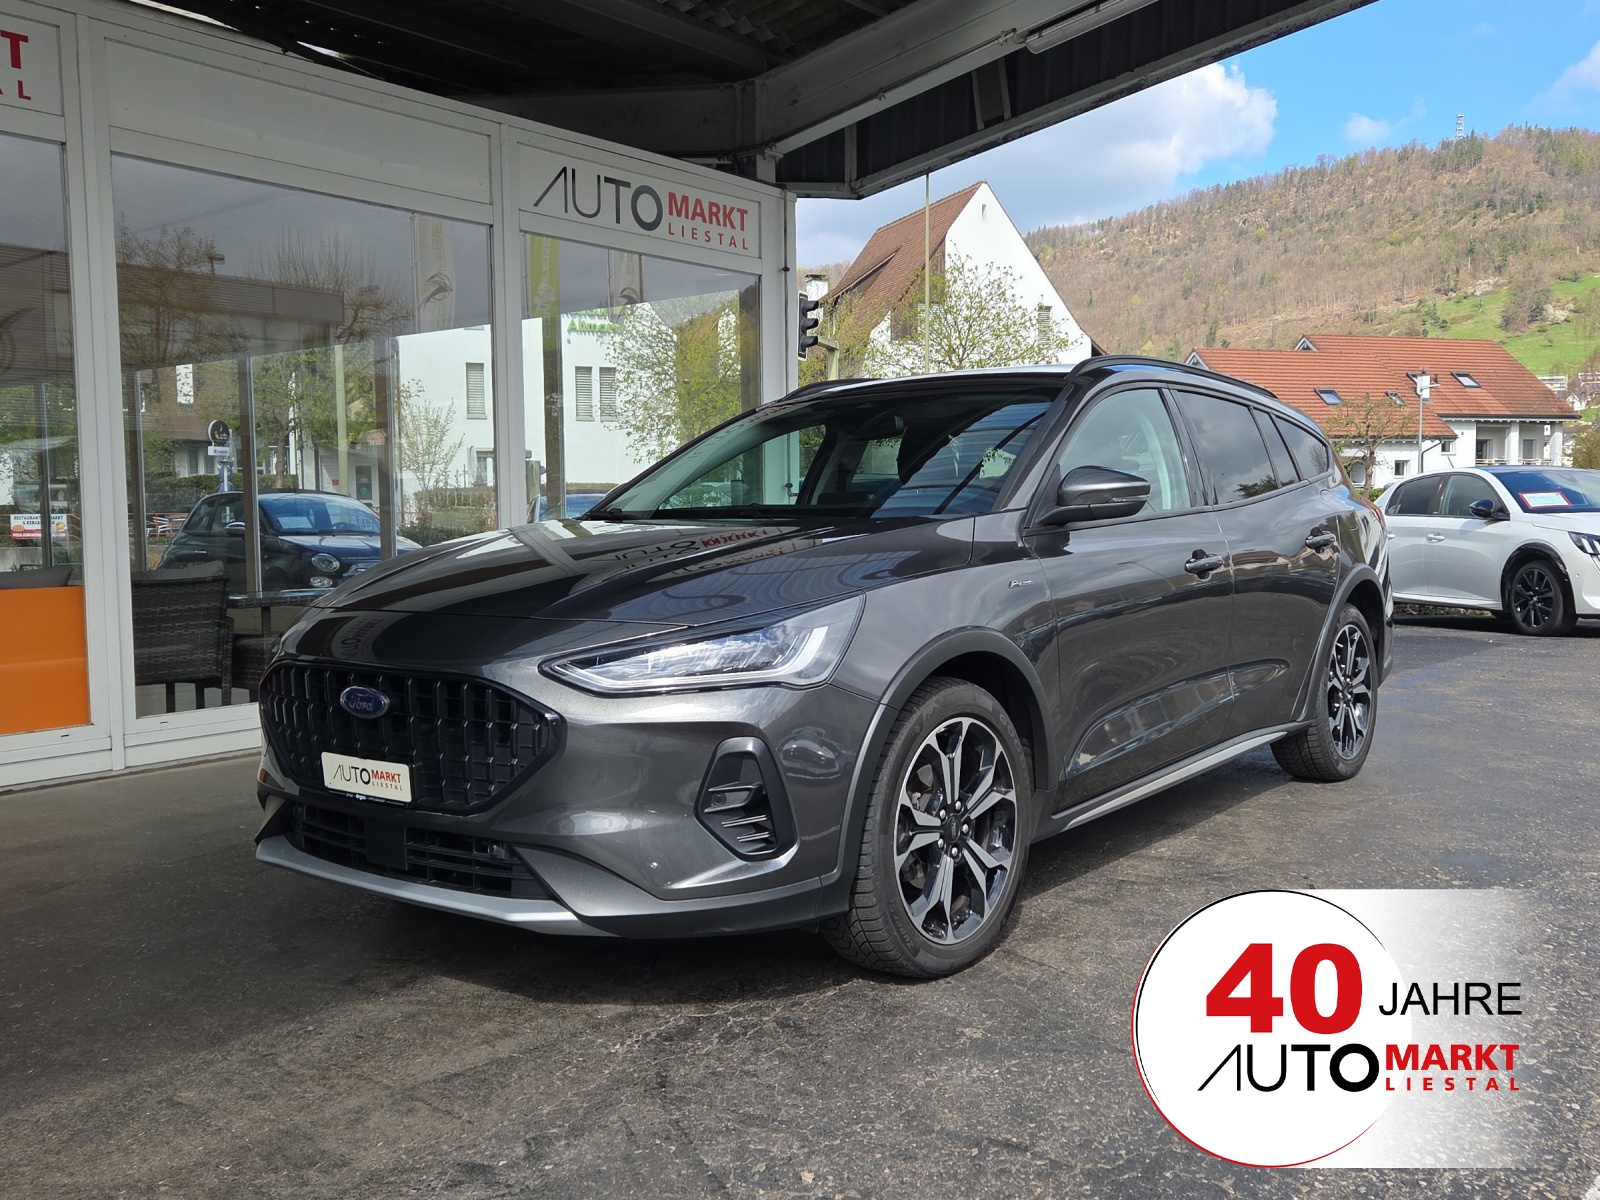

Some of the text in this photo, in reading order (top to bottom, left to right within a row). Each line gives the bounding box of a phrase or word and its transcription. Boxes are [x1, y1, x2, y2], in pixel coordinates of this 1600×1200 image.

[533, 166, 748, 232] AUTO MARKT
[668, 222, 748, 251] LIESTAL
[333, 764, 401, 785] AUTO MARKT
[372, 781, 403, 791] LIESTAL
